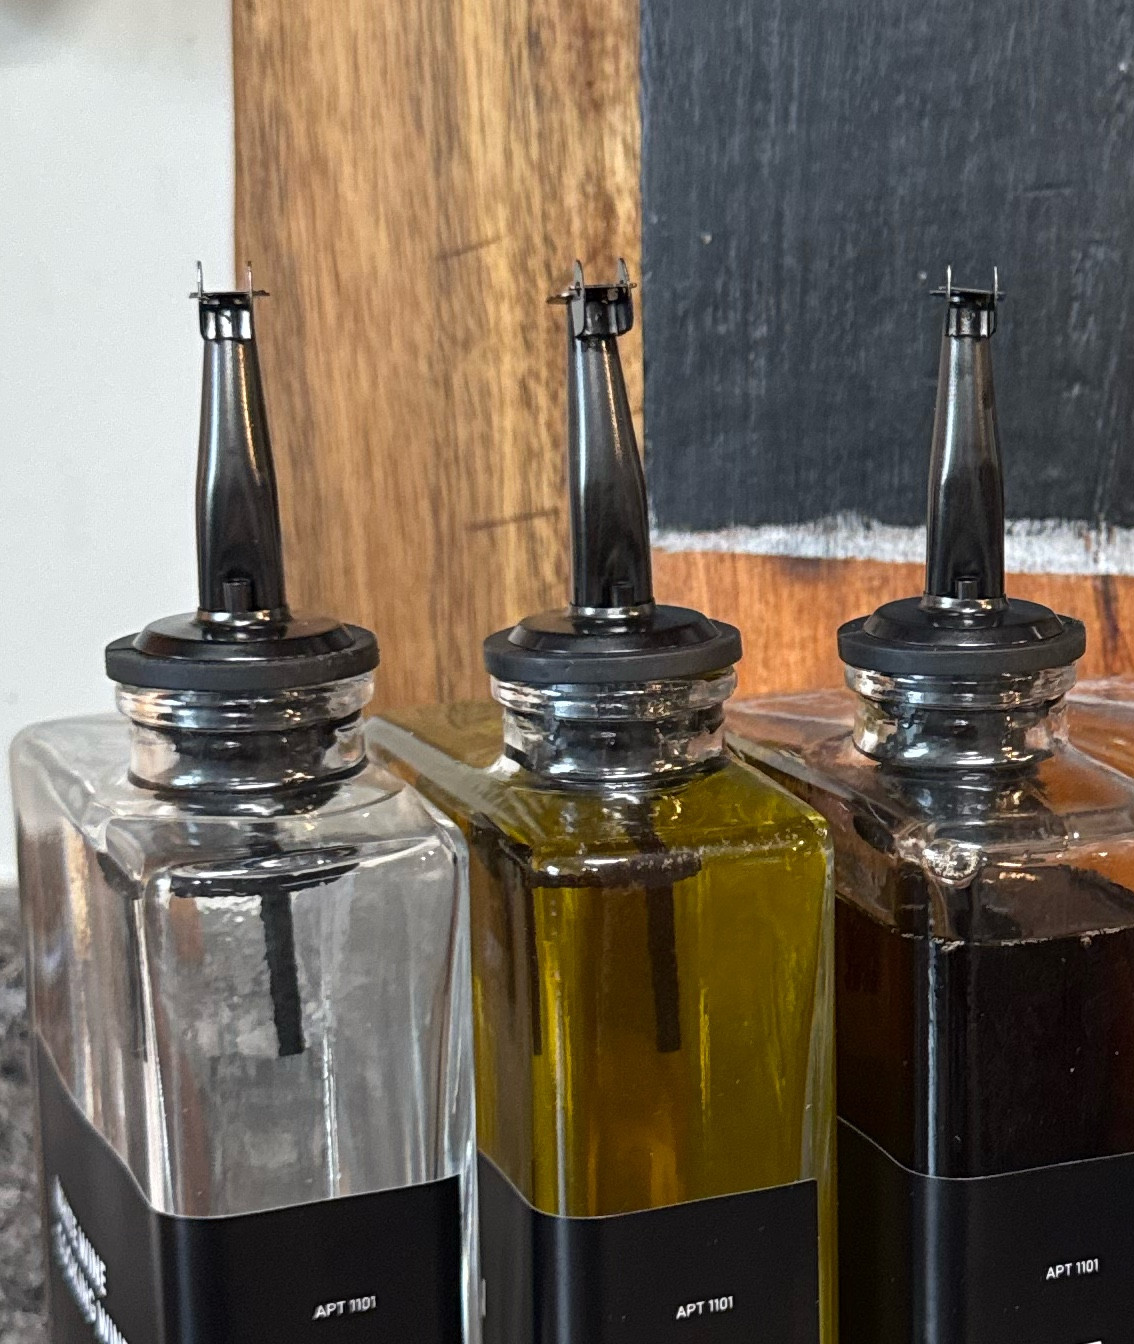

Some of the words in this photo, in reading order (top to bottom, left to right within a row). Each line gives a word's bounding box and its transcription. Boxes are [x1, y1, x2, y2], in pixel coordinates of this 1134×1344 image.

[1045, 1264, 1073, 1281] APT
[1075, 1258, 1099, 1276] 1101
[313, 1300, 347, 1319] APT
[348, 1295, 377, 1313] 1101
[675, 1300, 705, 1320] APT
[708, 1295, 734, 1313] 1101
